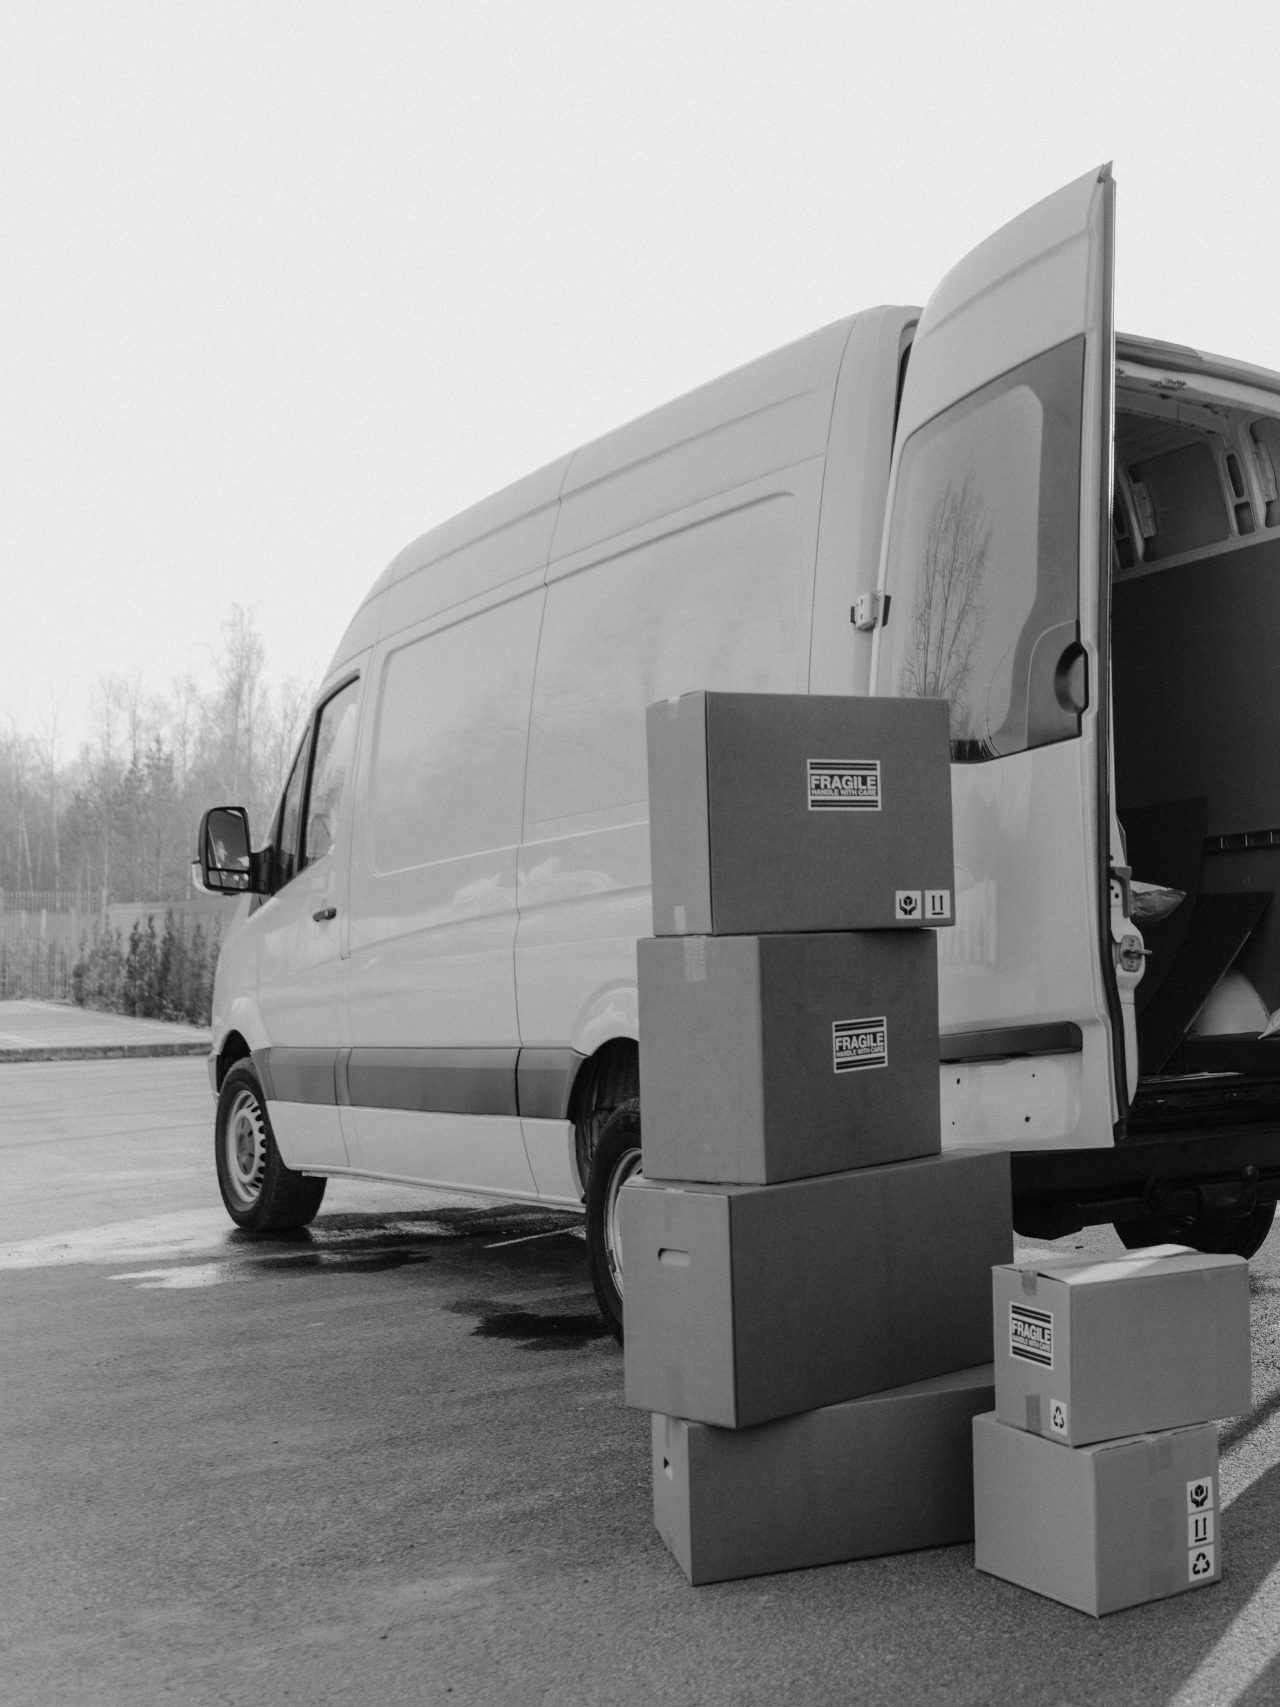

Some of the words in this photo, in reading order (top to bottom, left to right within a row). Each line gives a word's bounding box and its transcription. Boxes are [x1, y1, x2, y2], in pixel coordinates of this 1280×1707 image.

[811, 775, 877, 790] FRAGILE
[835, 1032, 884, 1051] FRAGILE
[1012, 1320, 1051, 1345] FRAGILE
